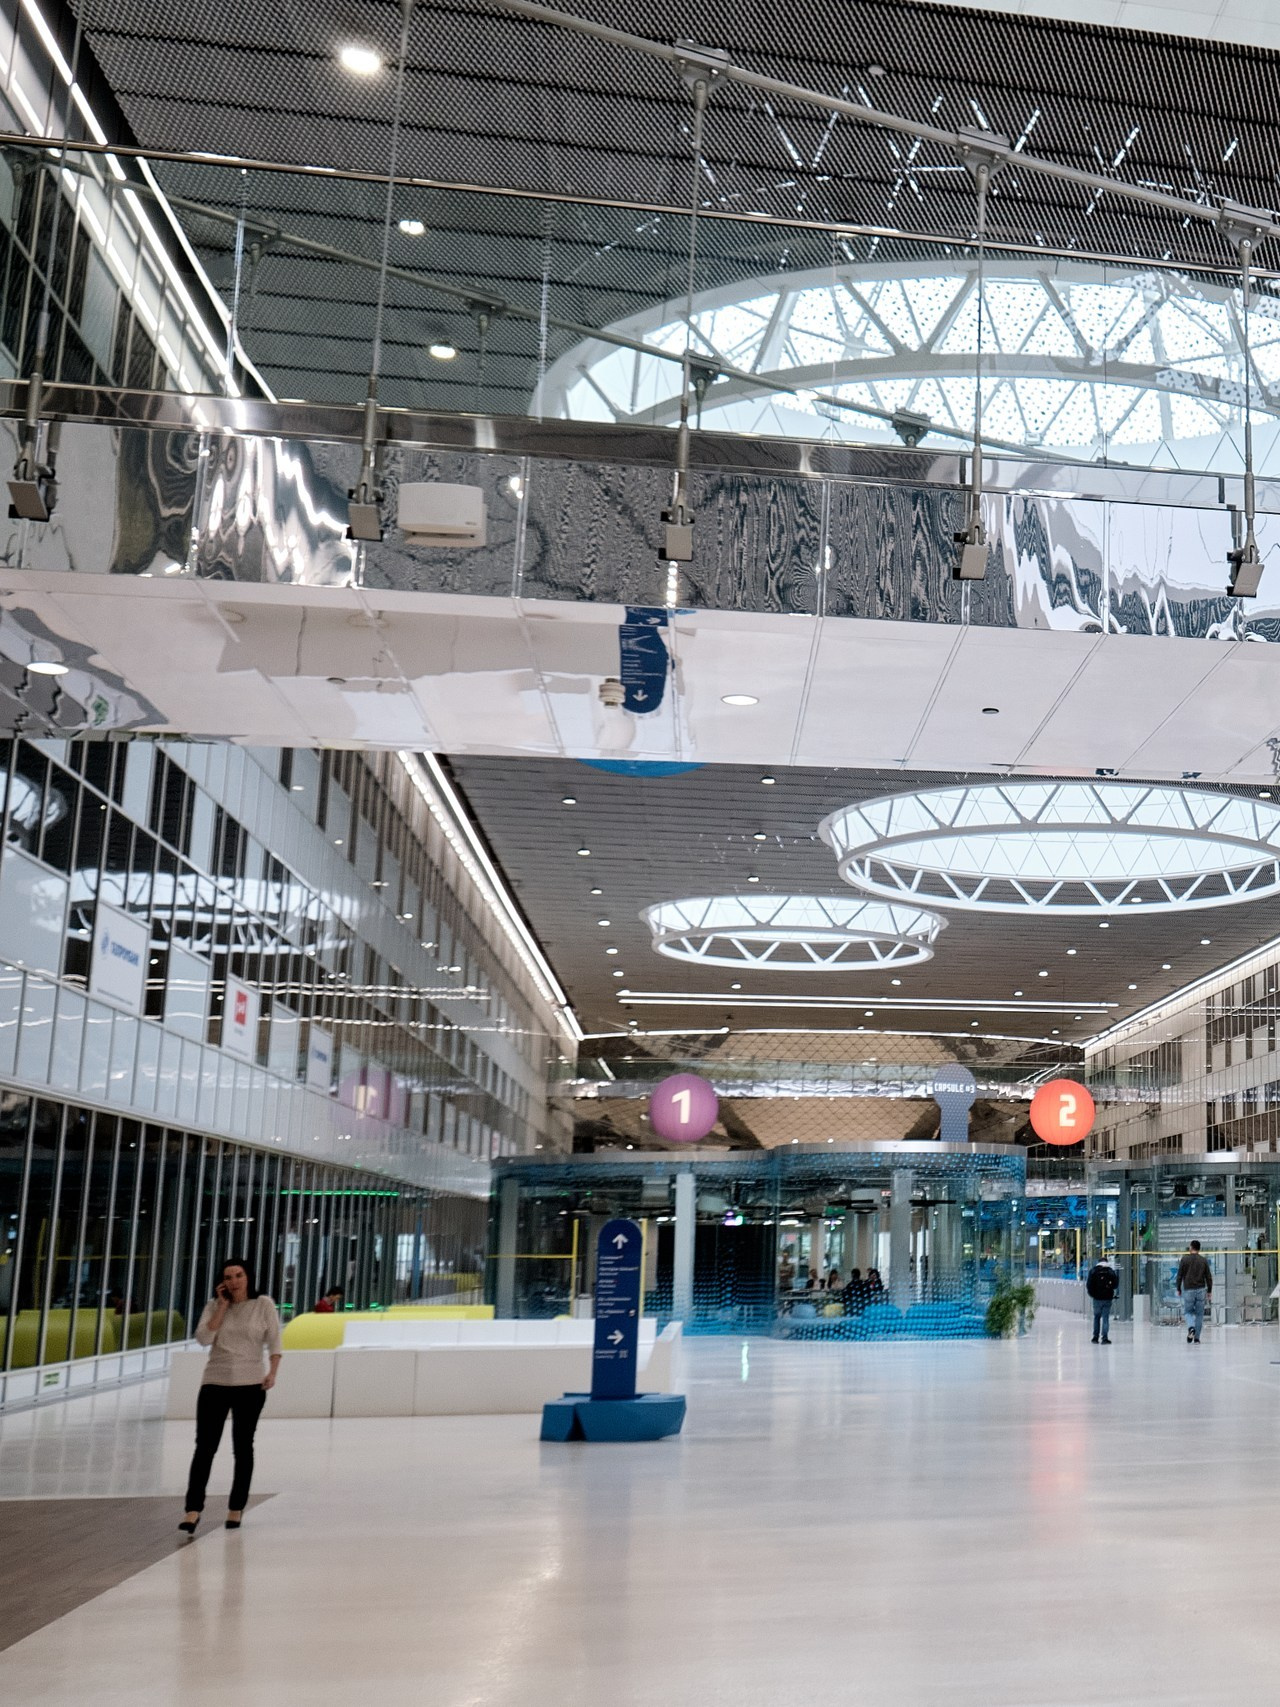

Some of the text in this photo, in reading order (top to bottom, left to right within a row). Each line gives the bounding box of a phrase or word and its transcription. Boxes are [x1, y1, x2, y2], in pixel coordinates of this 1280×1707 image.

[934, 1083, 975, 1093] CAPSULE #3
[672, 1089, 690, 1123] 1
[1059, 1094, 1077, 1127] 2
